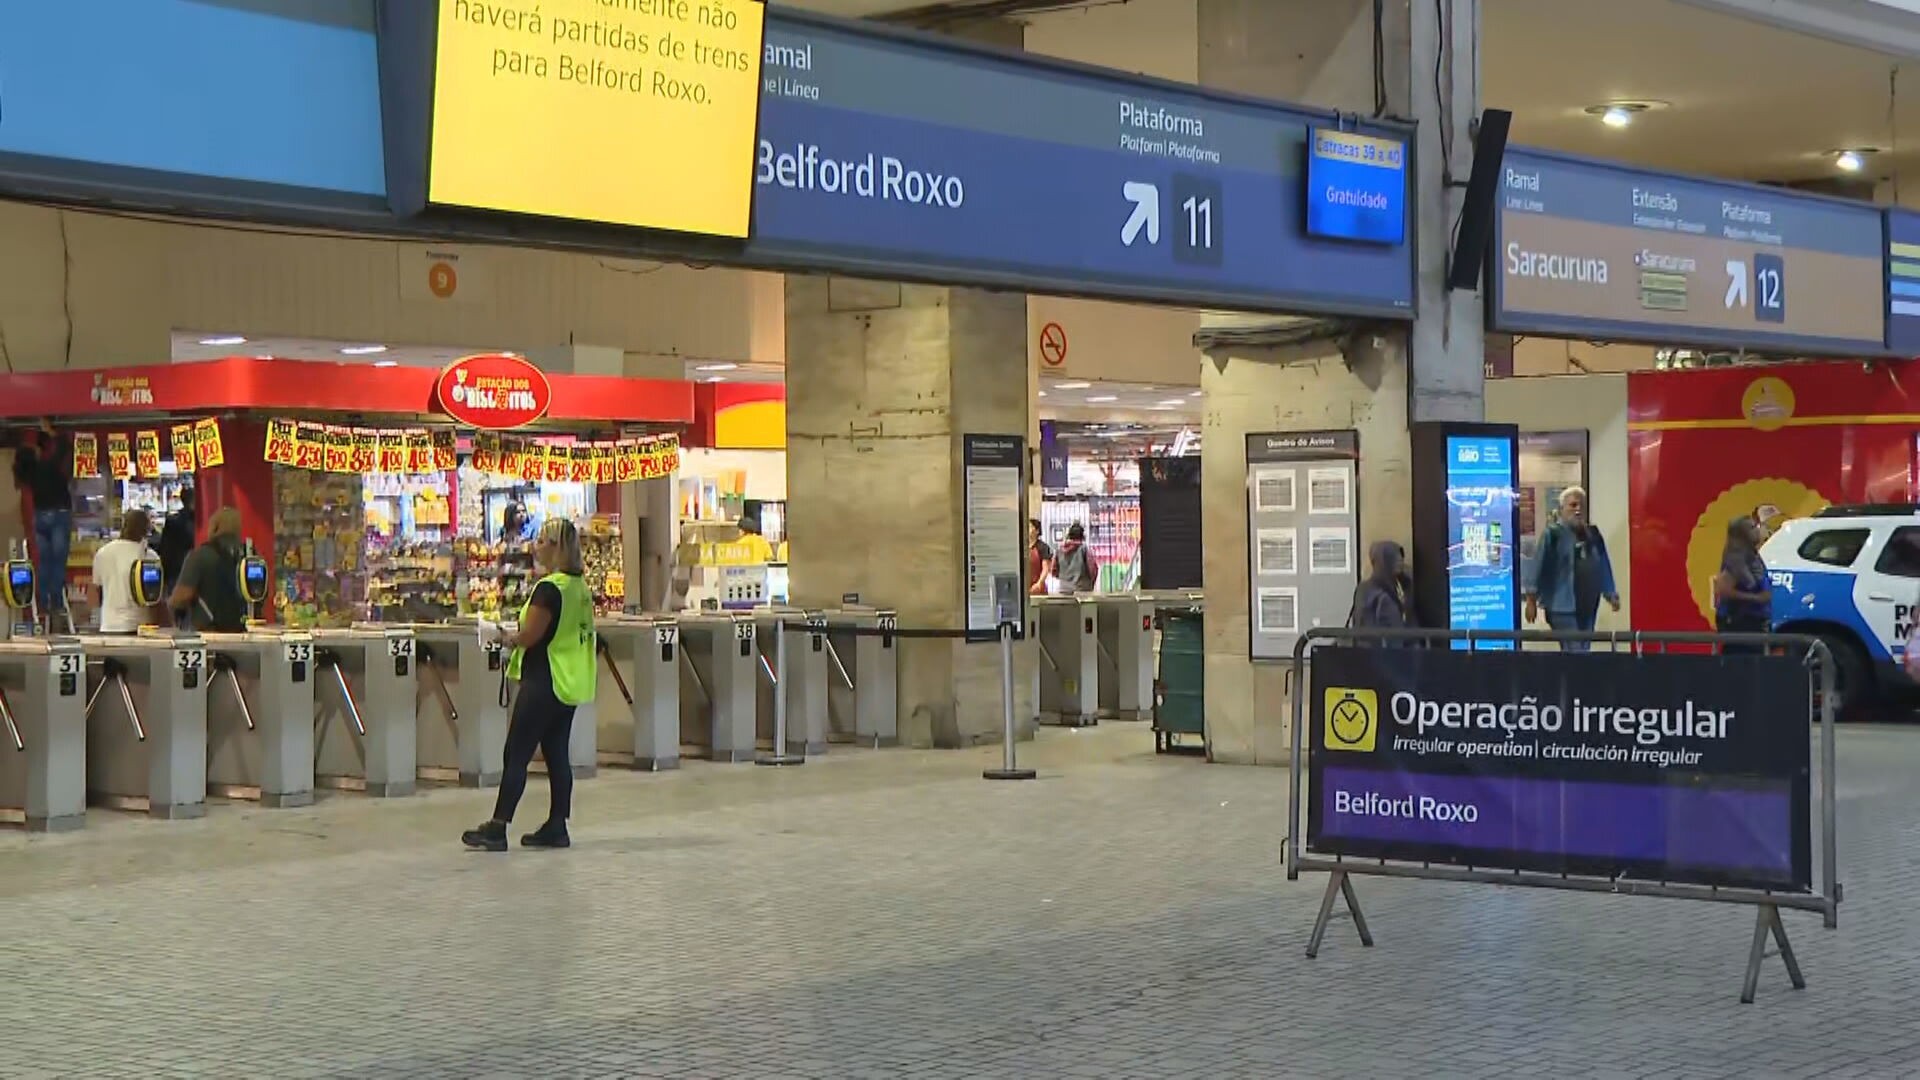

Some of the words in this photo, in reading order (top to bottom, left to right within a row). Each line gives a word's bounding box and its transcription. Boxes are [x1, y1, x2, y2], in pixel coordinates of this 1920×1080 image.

[698, 1, 737, 30] não
[455, 0, 541, 34] haverá
[553, 16, 649, 53] partidas
[658, 31, 685, 60] de
[694, 39, 749, 72] trens
[764, 44, 811, 70] amal
[492, 48, 547, 77] para
[558, 54, 642, 93] Belford
[652, 71, 712, 104] Roxo.
[785, 78, 819, 100] Línea
[1120, 101, 1203, 136] Plataforma
[1121, 135, 1162, 155] Platform
[1168, 141, 1220, 163] Plataforma
[757, 139, 874, 197] Belford
[882, 156, 964, 209] Roxo
[1506, 169, 1539, 192] Ramal
[1326, 185, 1387, 210] Gratuidade
[1632, 188, 1678, 212] Extensão
[1183, 196, 1211, 248] 11
[1722, 201, 1771, 225] Plataforma
[1507, 242, 1608, 285] Saracuruna
[438, 271, 448, 289] 9
[1758, 268, 1780, 309] 12
[658, 628, 675, 643] 37
[736, 624, 752, 639] 38
[178, 651, 201, 669] 32
[288, 645, 310, 661] 33
[391, 640, 412, 657] 34
[59, 655, 81, 673] 31
[1391, 691, 1563, 738] Operação
[1573, 698, 1735, 745] irregular
[1393, 735, 1454, 755] irregular
[1457, 739, 1532, 758] operation
[1542, 743, 1628, 761] circulación
[1631, 745, 1703, 768] irregular
[1335, 790, 1414, 818] Belford
[1419, 796, 1478, 823] Roxo
